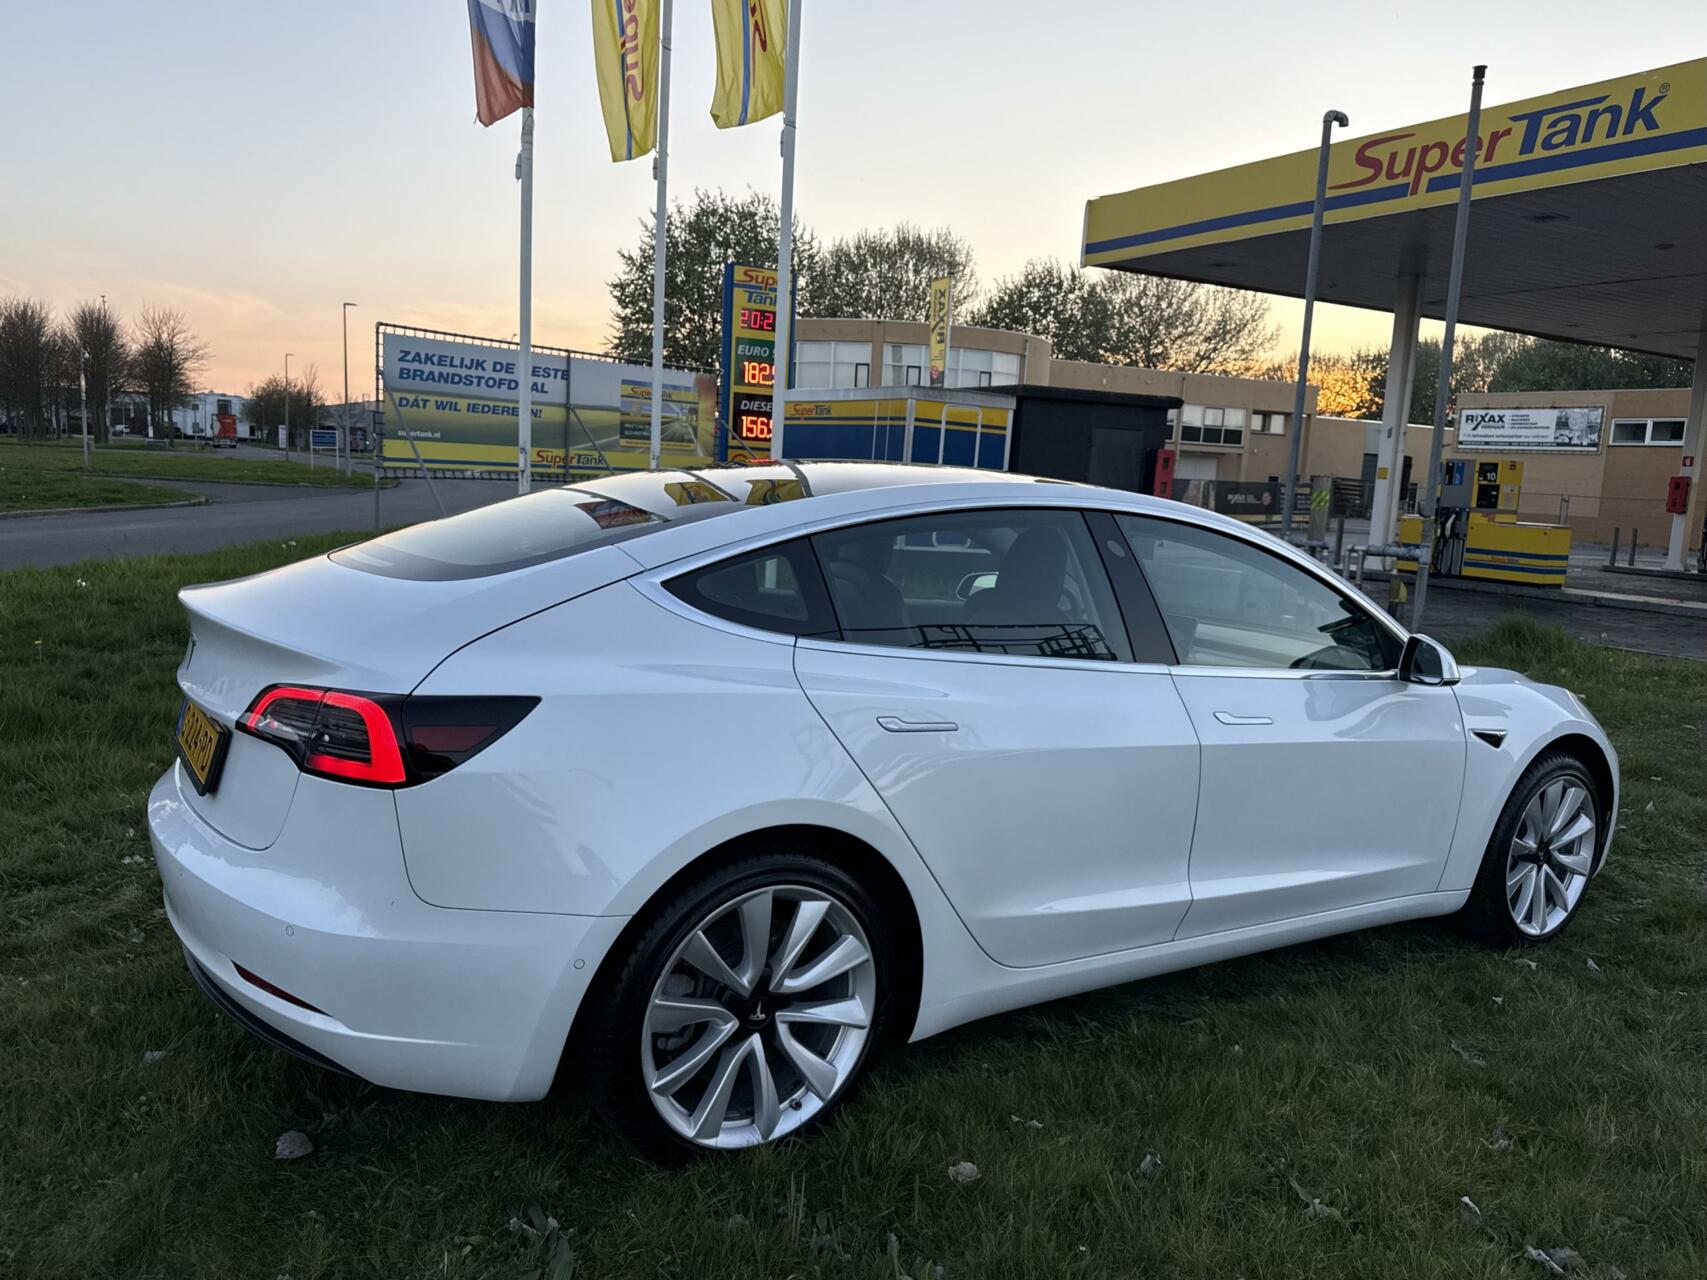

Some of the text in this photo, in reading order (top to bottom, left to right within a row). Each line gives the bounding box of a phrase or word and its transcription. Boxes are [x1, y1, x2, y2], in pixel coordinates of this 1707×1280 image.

[736, 268, 777, 292] Sup
[743, 289, 777, 306] Tan
[739, 310, 774, 330] 20:2
[737, 345, 769, 357] EURO
[398, 350, 569, 380] ZAKELIJK DE ESTE
[398, 367, 549, 394] BRANDSTOFDAL
[398, 395, 543, 418] DÁT WIL IEDEREN!
[740, 400, 773, 412] DIESE
